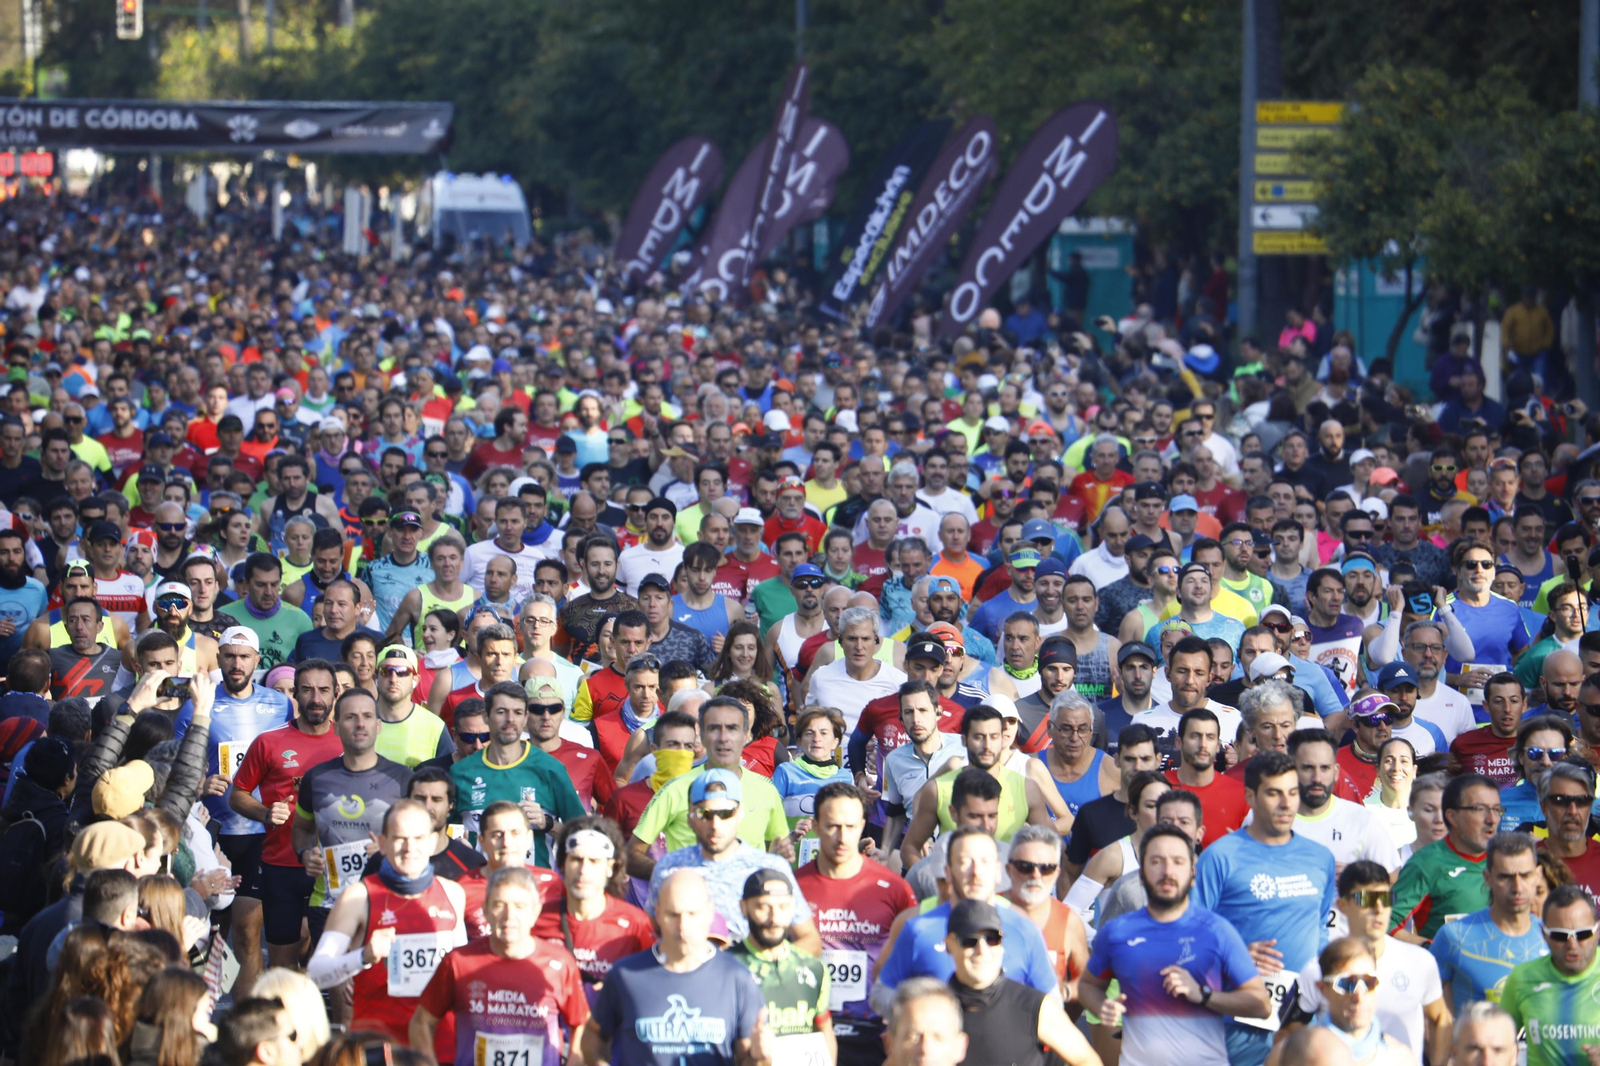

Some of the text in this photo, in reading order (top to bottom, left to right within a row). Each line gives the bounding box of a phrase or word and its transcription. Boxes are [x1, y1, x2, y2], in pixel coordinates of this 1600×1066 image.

[50, 107, 79, 128] DE
[85, 105, 199, 131] CÓRDOBA
[887, 130, 991, 283] IMDECO
[950, 110, 1105, 323] IMDECO
[105, 601, 137, 611] RIDA
[1474, 767, 1515, 776] 36 MARA
[341, 850, 368, 873] 59
[818, 909, 858, 921] MEDIA
[818, 919, 880, 934] MARATÓN
[487, 989, 526, 1003] MEDIA
[469, 1000, 549, 1018] 36 MARATÓN
[494, 1049, 531, 1066] 871
